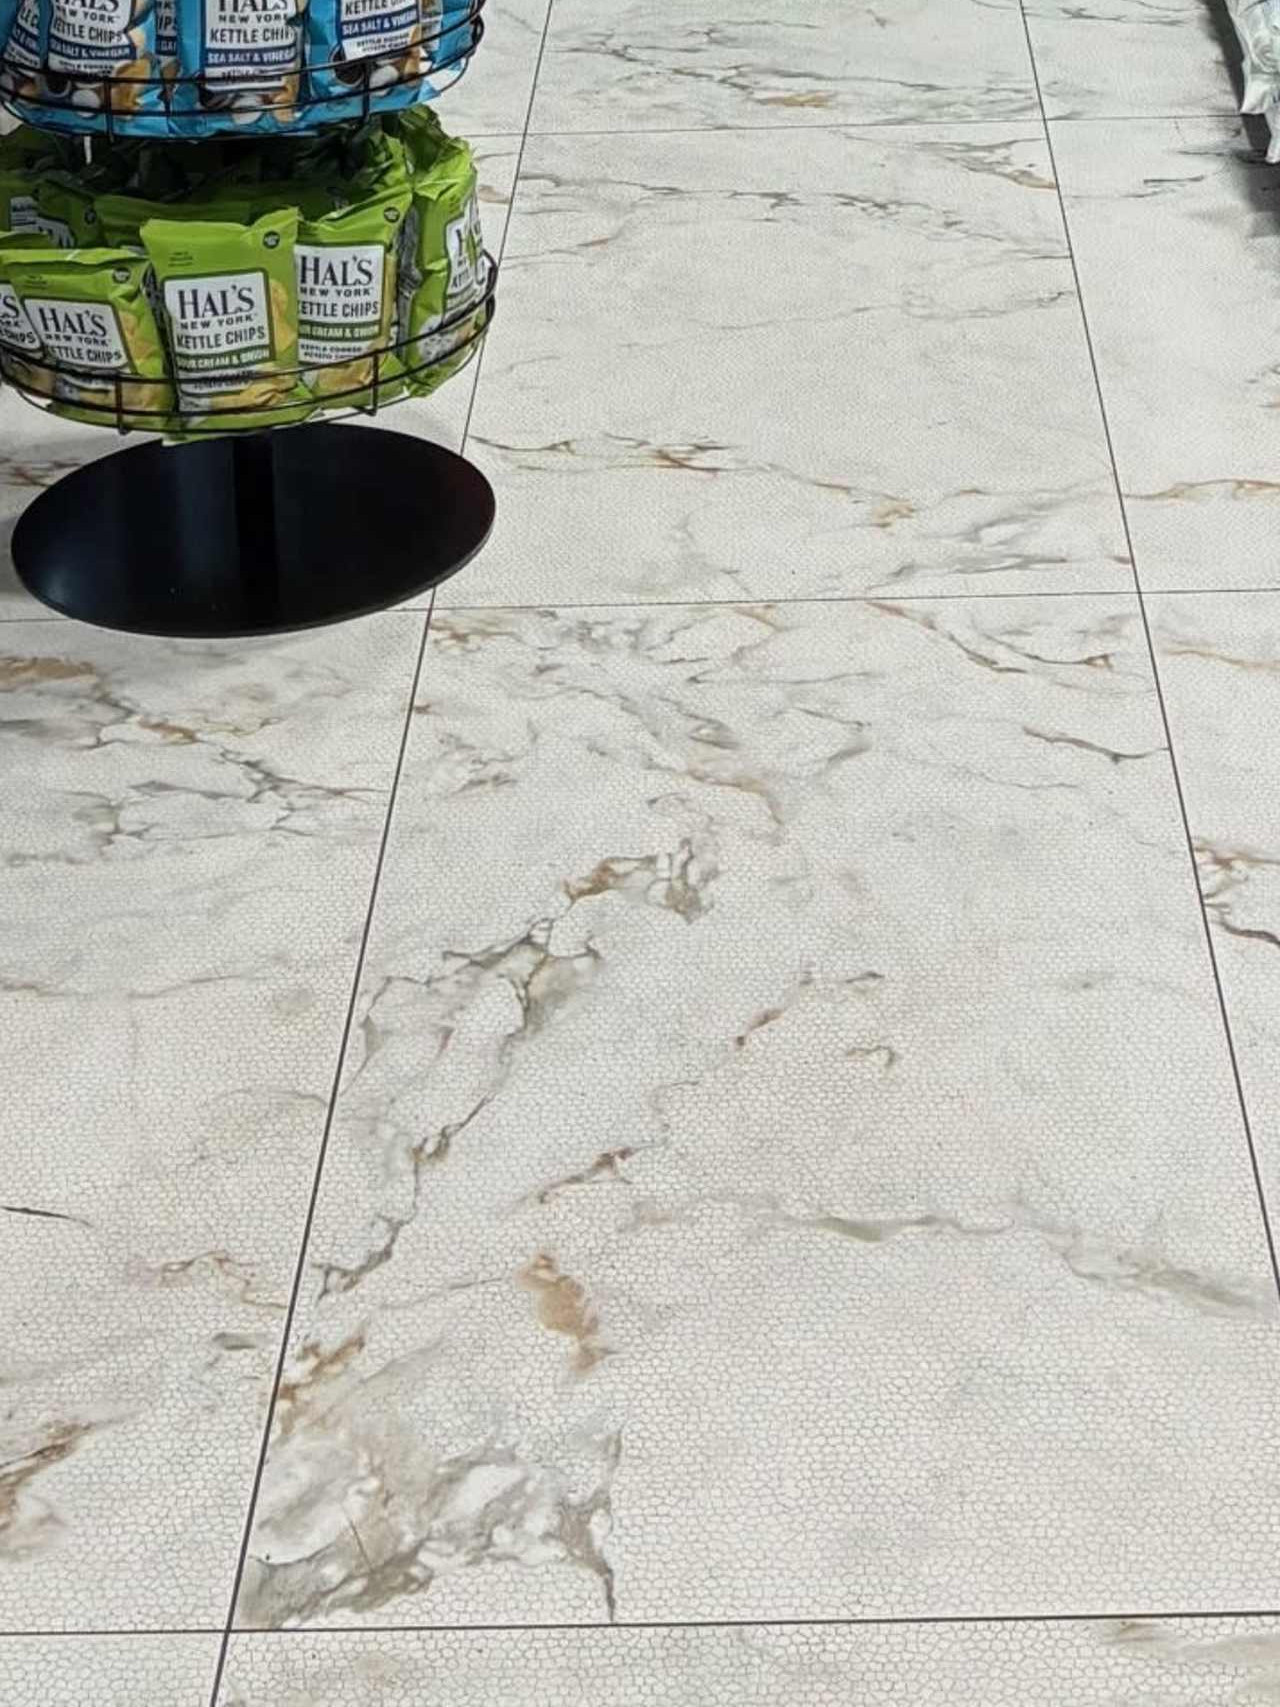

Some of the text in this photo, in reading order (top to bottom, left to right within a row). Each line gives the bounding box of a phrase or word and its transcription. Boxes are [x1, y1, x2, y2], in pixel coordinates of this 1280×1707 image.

[218, 12, 251, 24] NEW
[341, 21, 360, 35] SEA
[360, 17, 383, 34] SALT
[209, 26, 261, 45] KETTLE
[207, 51, 225, 64] SEA
[227, 51, 252, 64] SALT
[299, 254, 374, 287] HAL'S
[299, 285, 372, 297] NEW YORK
[177, 284, 256, 321] HAL'S
[342, 299, 380, 318] CHIPS
[38, 306, 108, 337] HAL'S
[179, 314, 255, 331] NEW YORK
[176, 325, 266, 351] KETTLE CHIPS
[85, 347, 122, 363] CHIPS
[197, 354, 230, 368] CREAM
